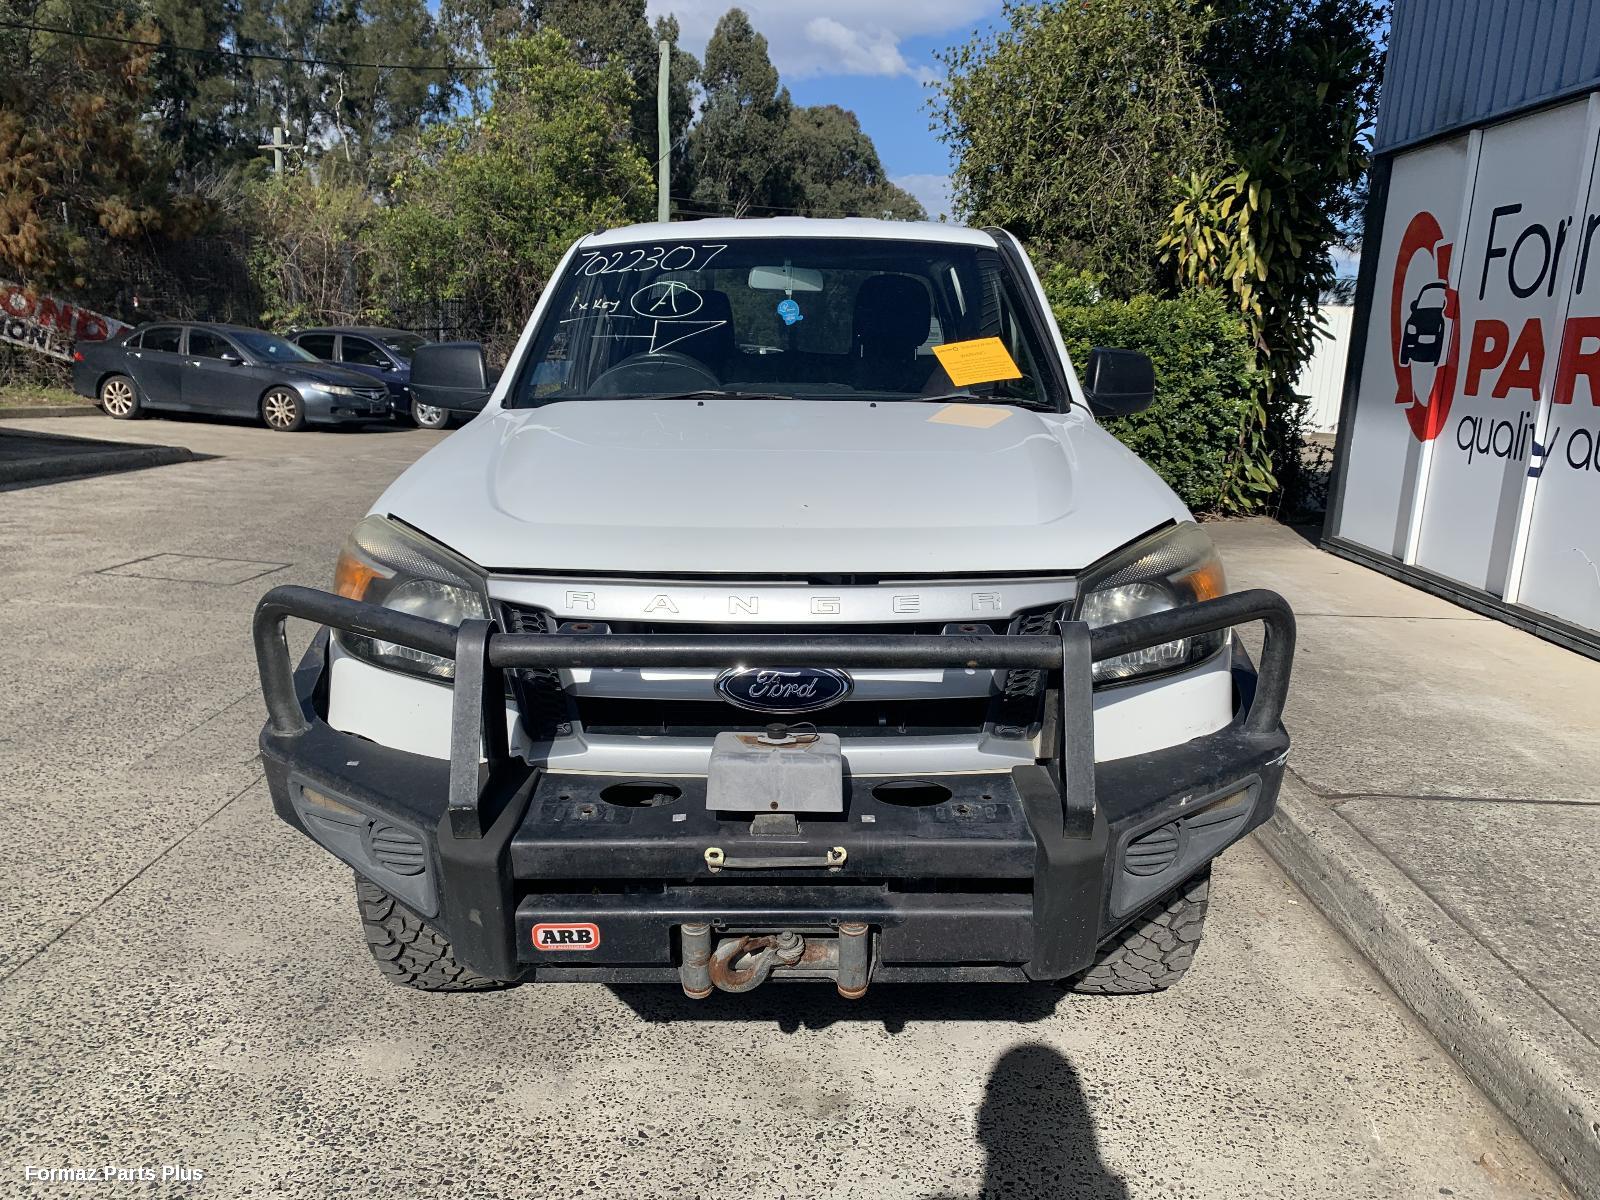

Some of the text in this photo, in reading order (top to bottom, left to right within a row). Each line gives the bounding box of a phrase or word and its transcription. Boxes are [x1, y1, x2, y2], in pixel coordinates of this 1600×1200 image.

[574, 244, 728, 276] 7022307
[565, 590, 1002, 615] RANGER
[749, 670, 819, 698] Ford
[541, 929, 593, 945] ARB
